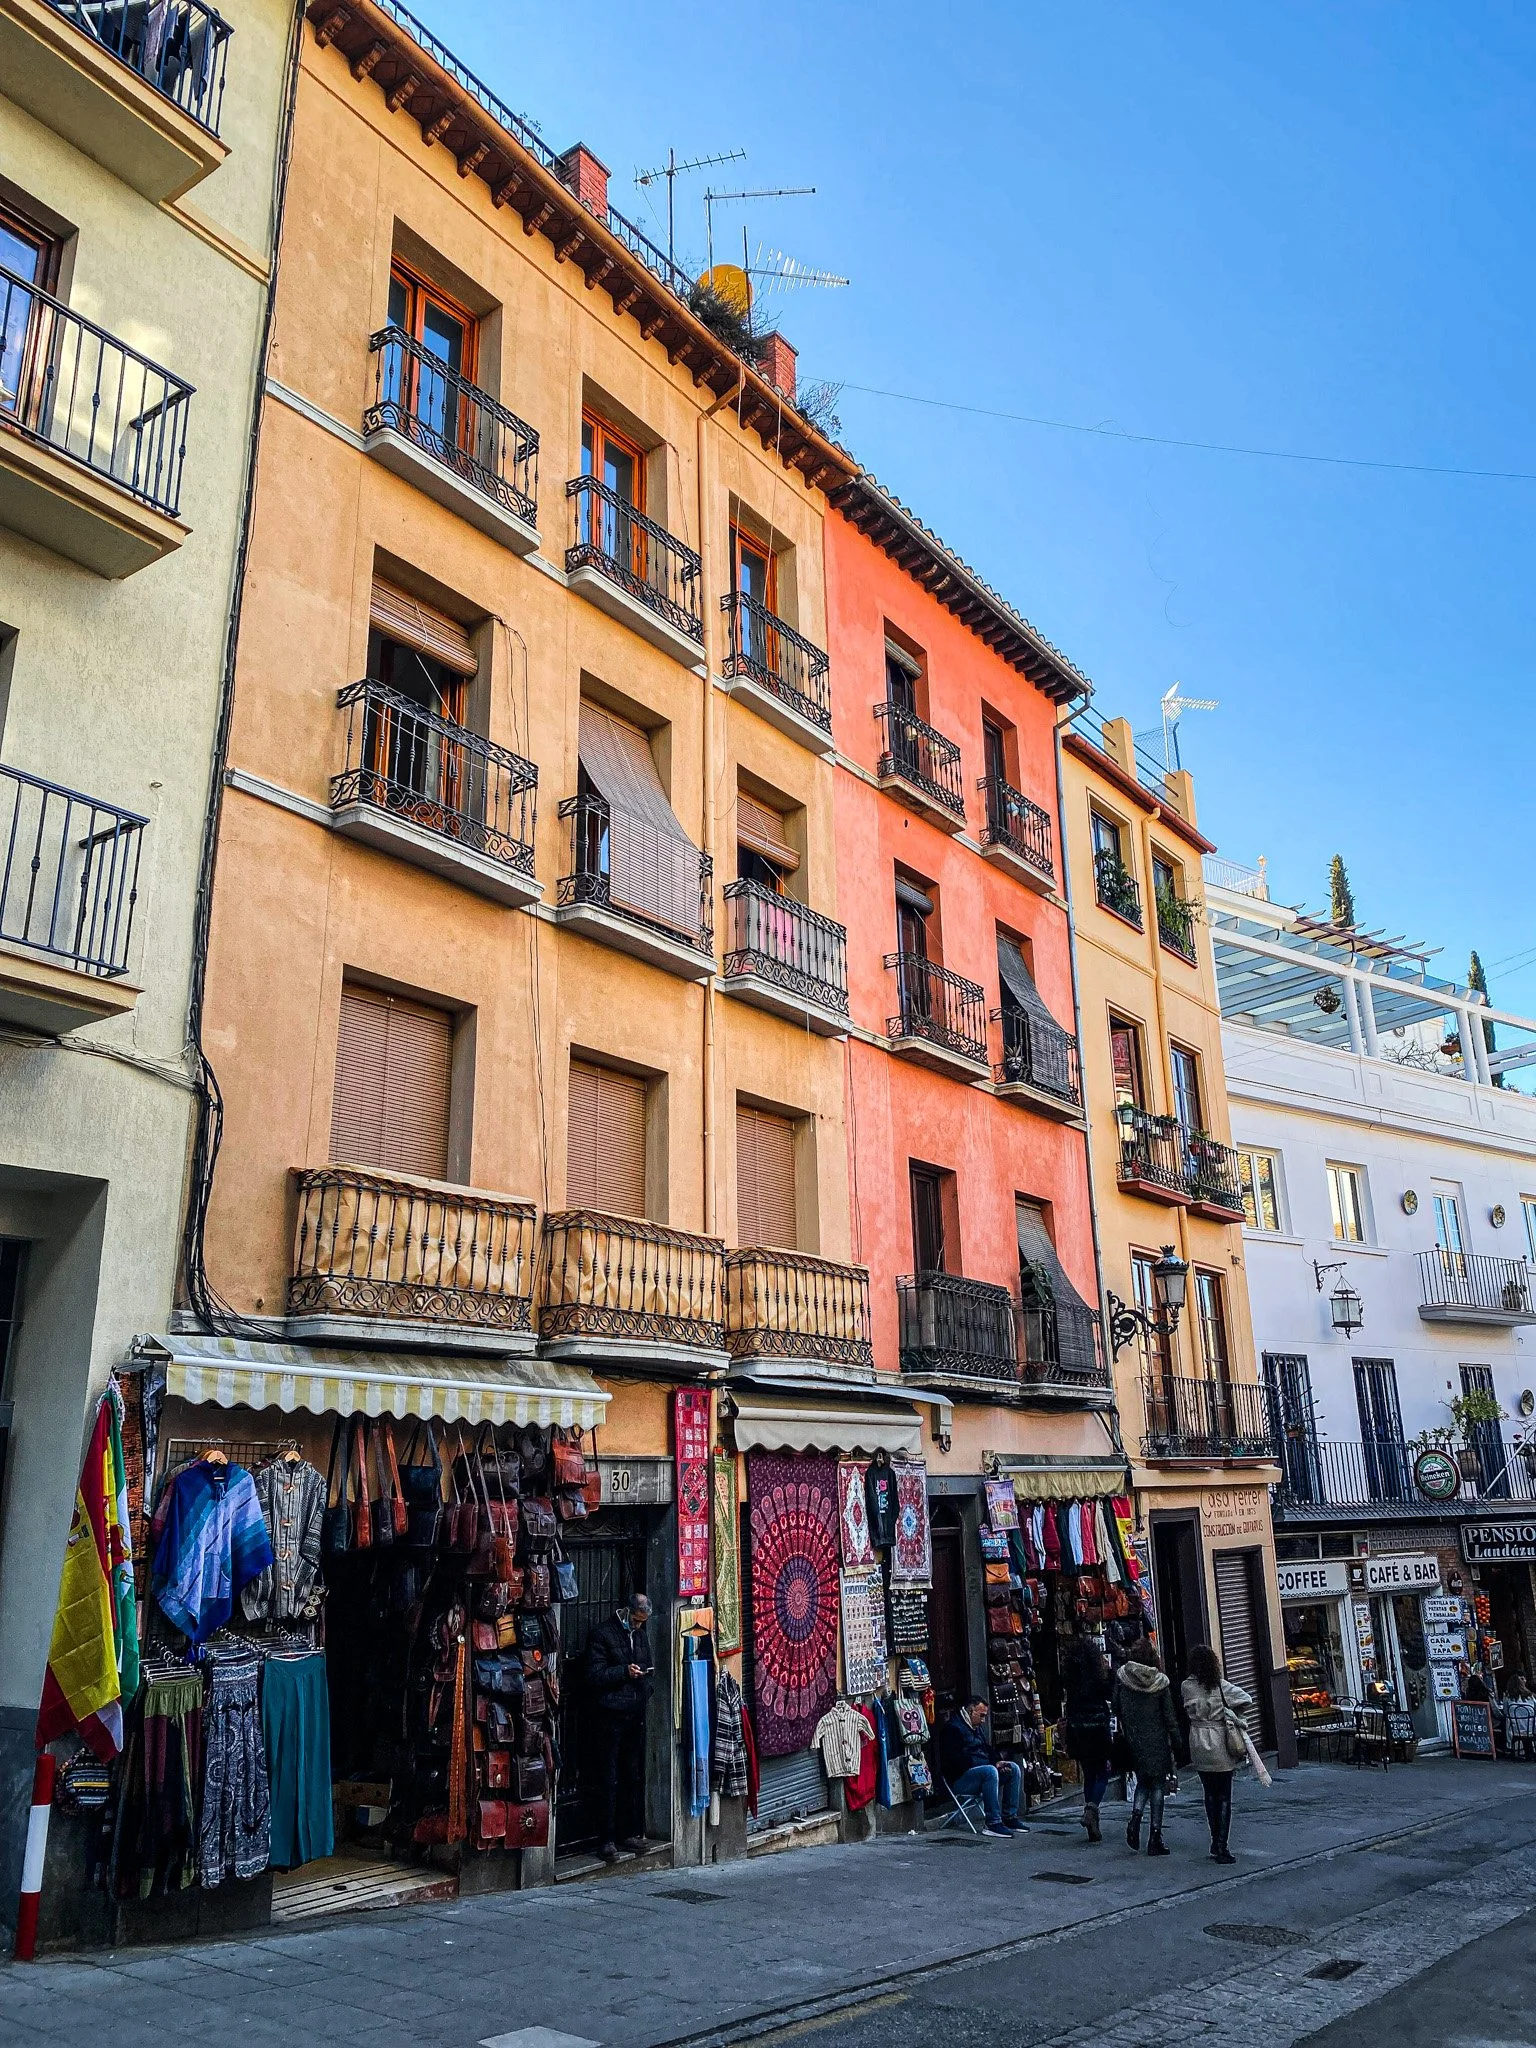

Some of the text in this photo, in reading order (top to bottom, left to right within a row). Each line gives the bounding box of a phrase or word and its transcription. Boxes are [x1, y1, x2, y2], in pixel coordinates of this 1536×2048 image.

[612, 1472, 629, 1491] 30
[1420, 1470, 1450, 1482] Heineken
[1200, 1486, 1230, 1518] Casa
[1466, 1526, 1536, 1543] PENSIO
[1474, 1544, 1536, 1558] Landázu
[1278, 1570, 1327, 1590] COFFEE
[1370, 1562, 1438, 1584] CAFÉ & BAR
[1430, 1636, 1451, 1644] CAÑA
[1464, 1724, 1488, 1732] QUESO
